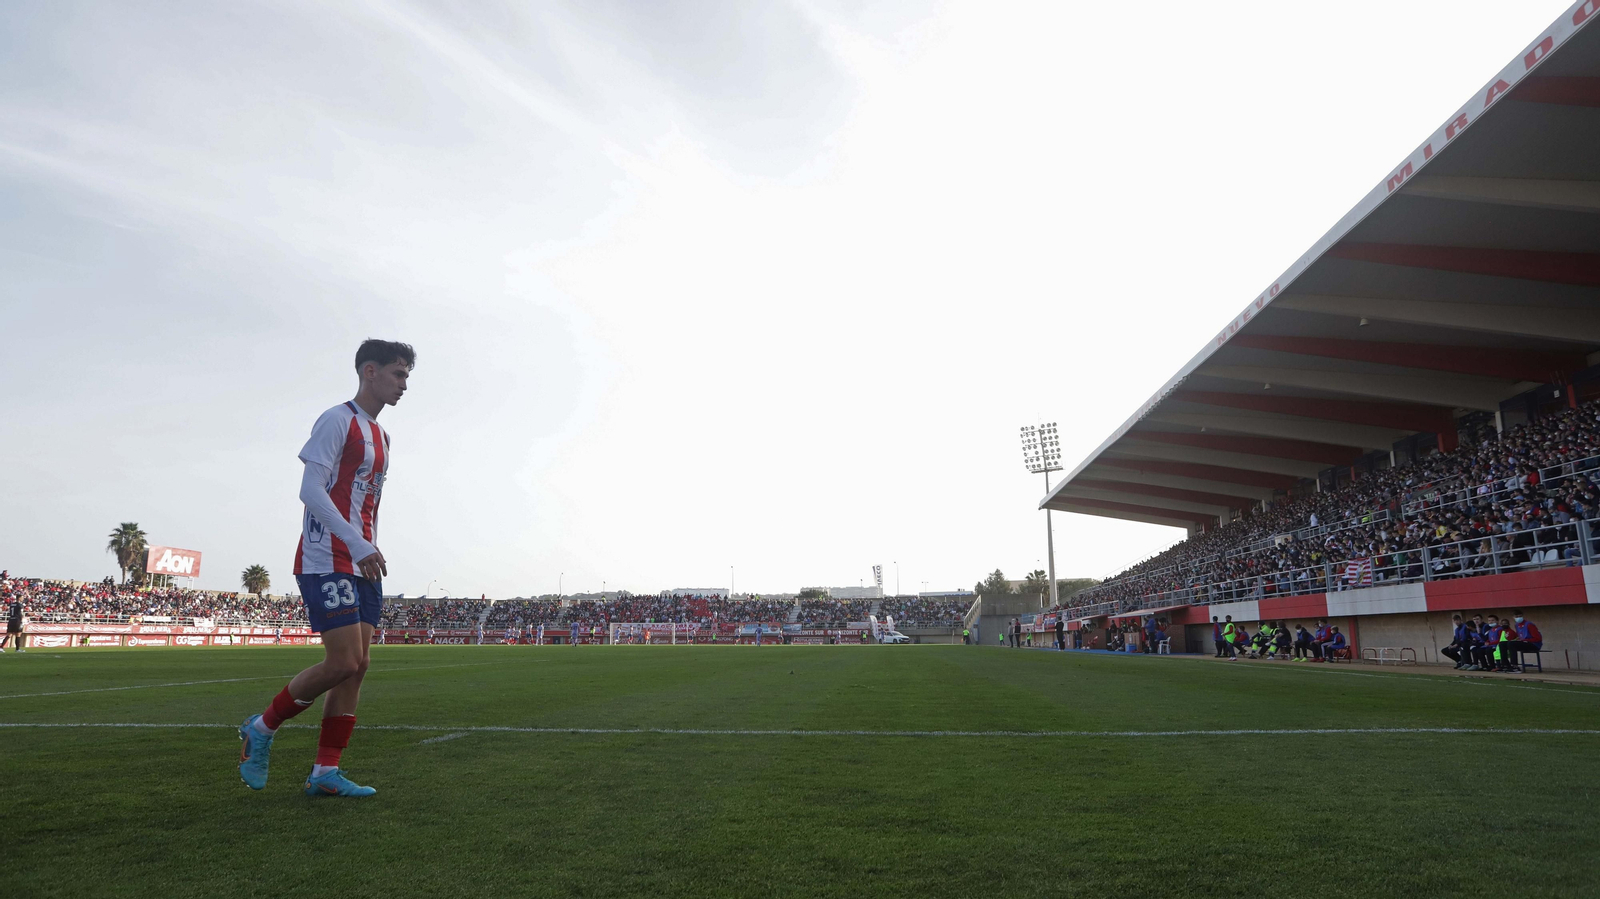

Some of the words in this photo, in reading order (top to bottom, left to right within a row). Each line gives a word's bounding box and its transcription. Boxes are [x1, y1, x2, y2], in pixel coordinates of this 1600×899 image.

[1217, 283, 1280, 346] NUEVO
[156, 549, 195, 574] AON
[321, 578, 356, 610] 33
